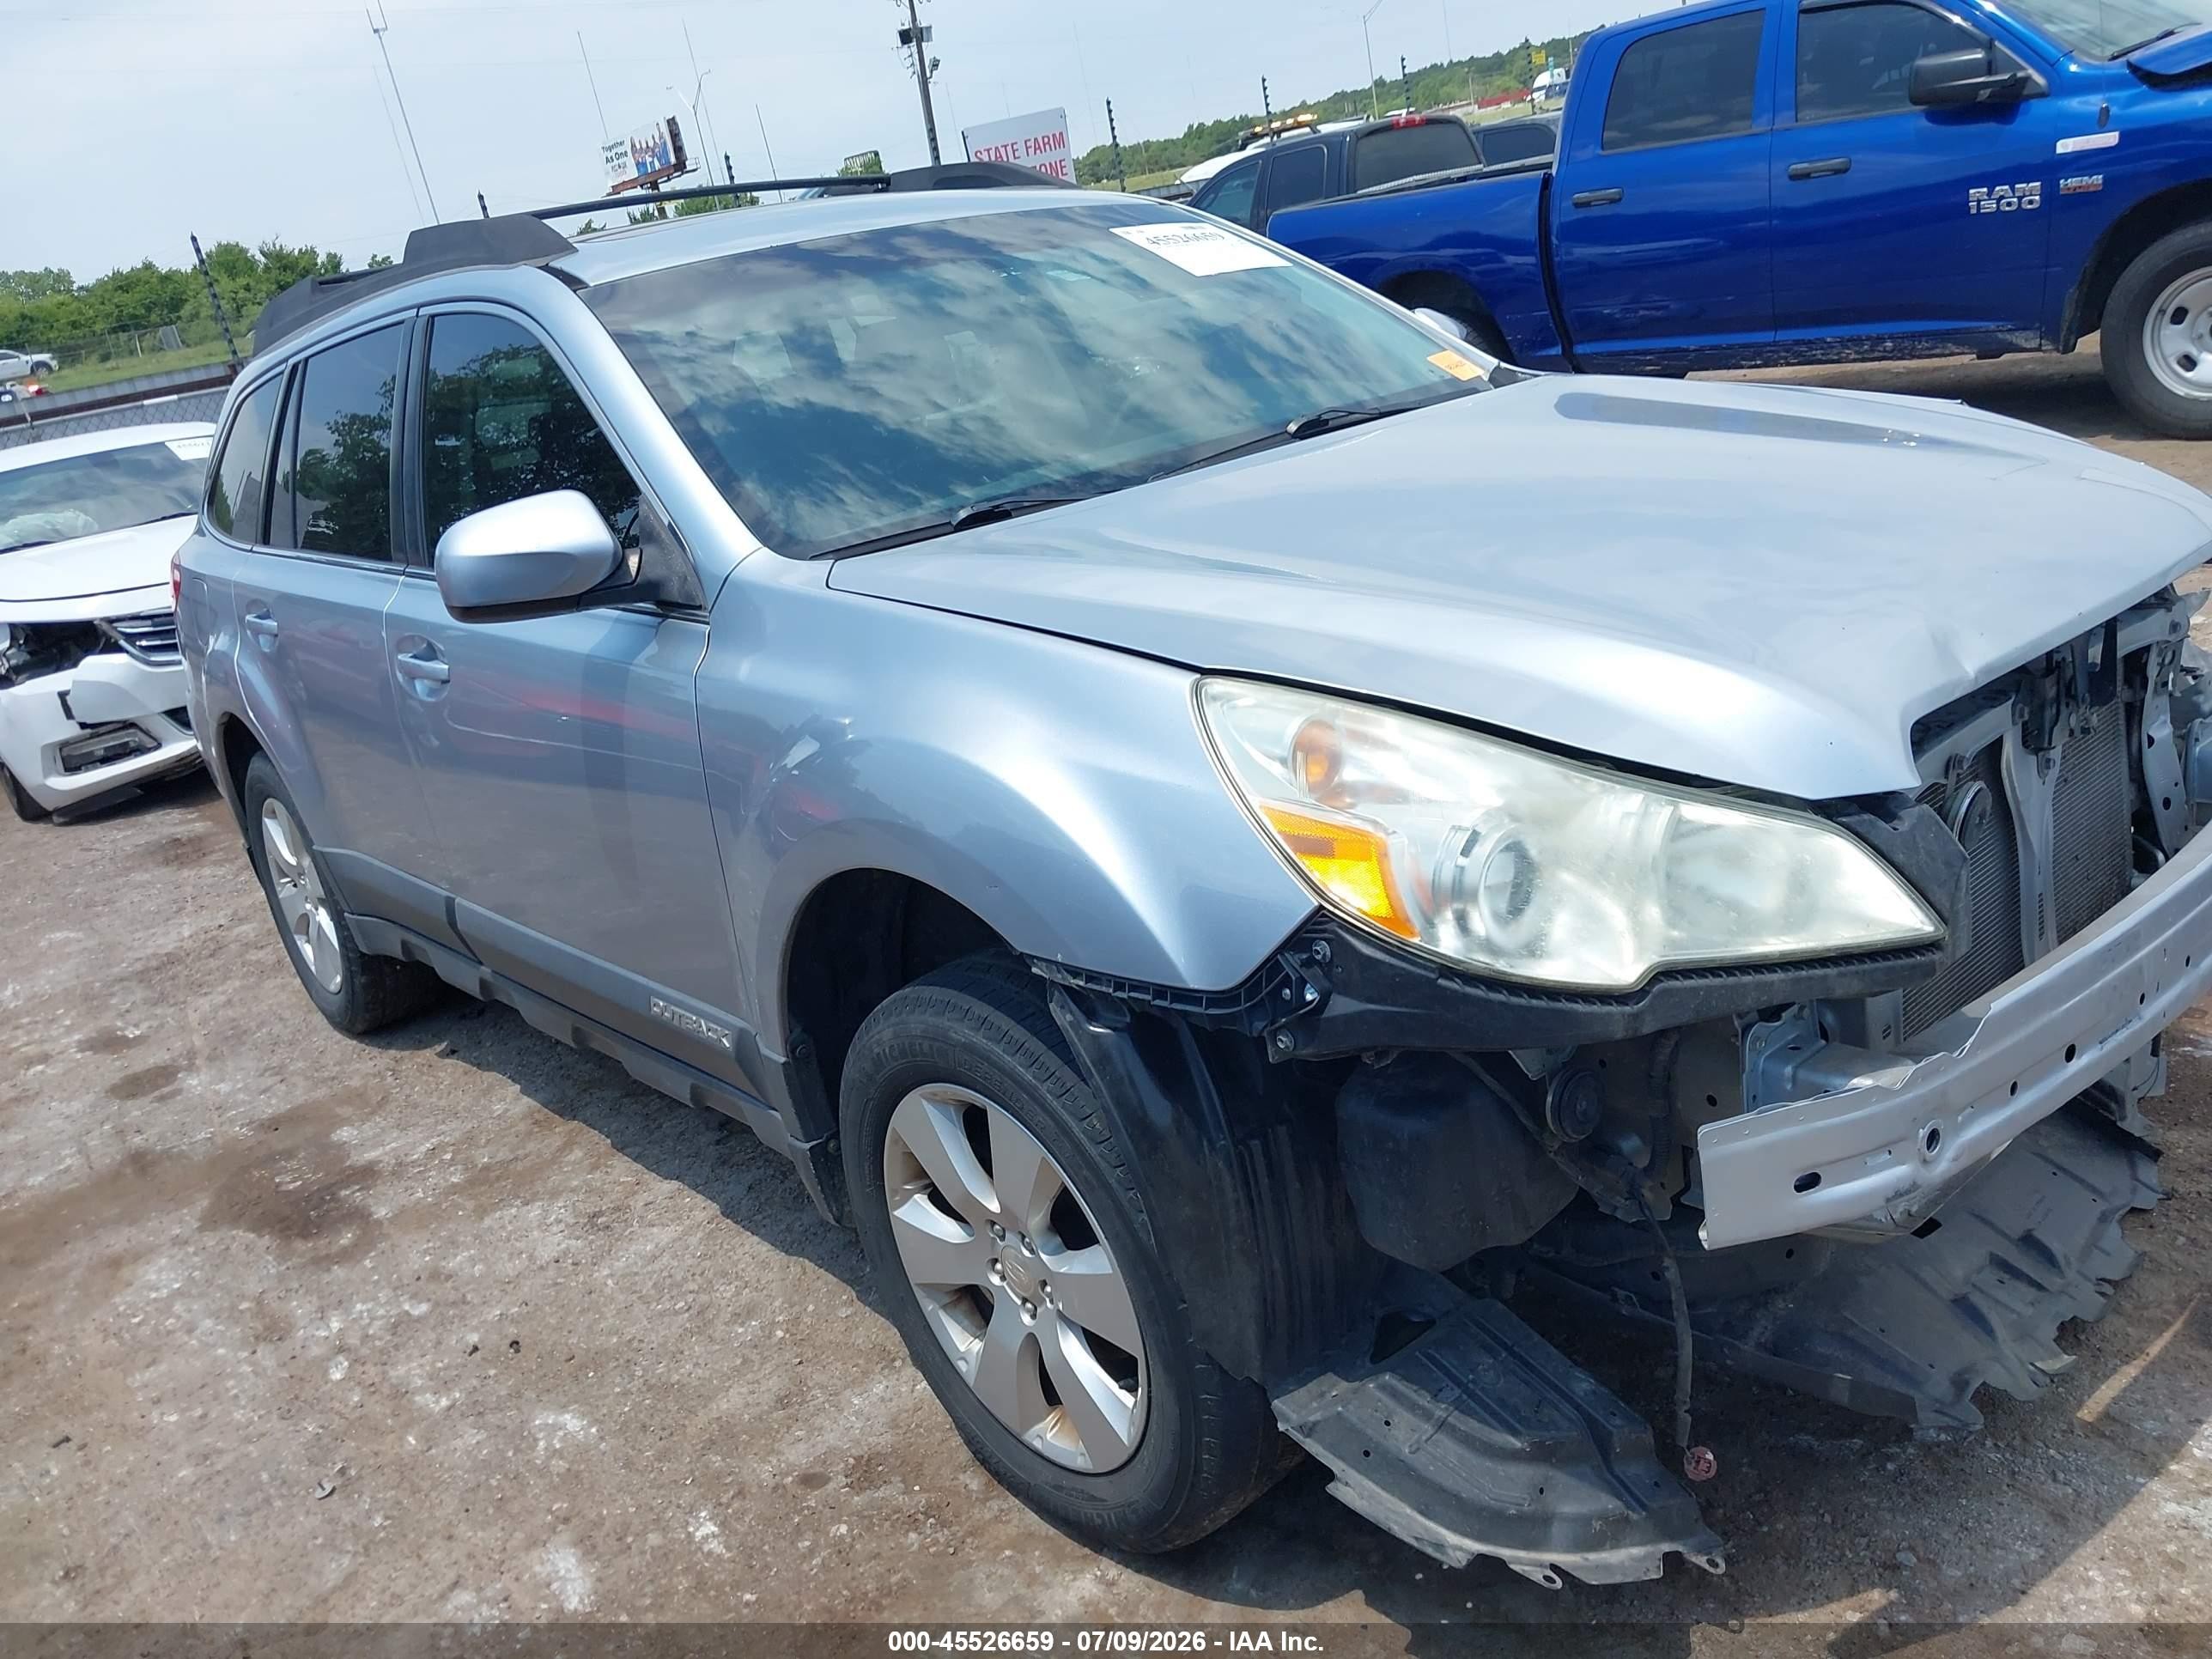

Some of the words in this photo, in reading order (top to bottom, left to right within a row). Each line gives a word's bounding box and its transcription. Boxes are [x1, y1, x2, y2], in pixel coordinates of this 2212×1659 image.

[601, 139, 625, 154] Together
[974, 142, 1021, 163] STATE
[1024, 131, 1066, 157] FARM
[605, 155, 615, 166] As
[614, 149, 629, 161] One
[2059, 174, 2103, 189] HEMI
[1968, 181, 2042, 204] RAM
[1968, 195, 2041, 215] 1500
